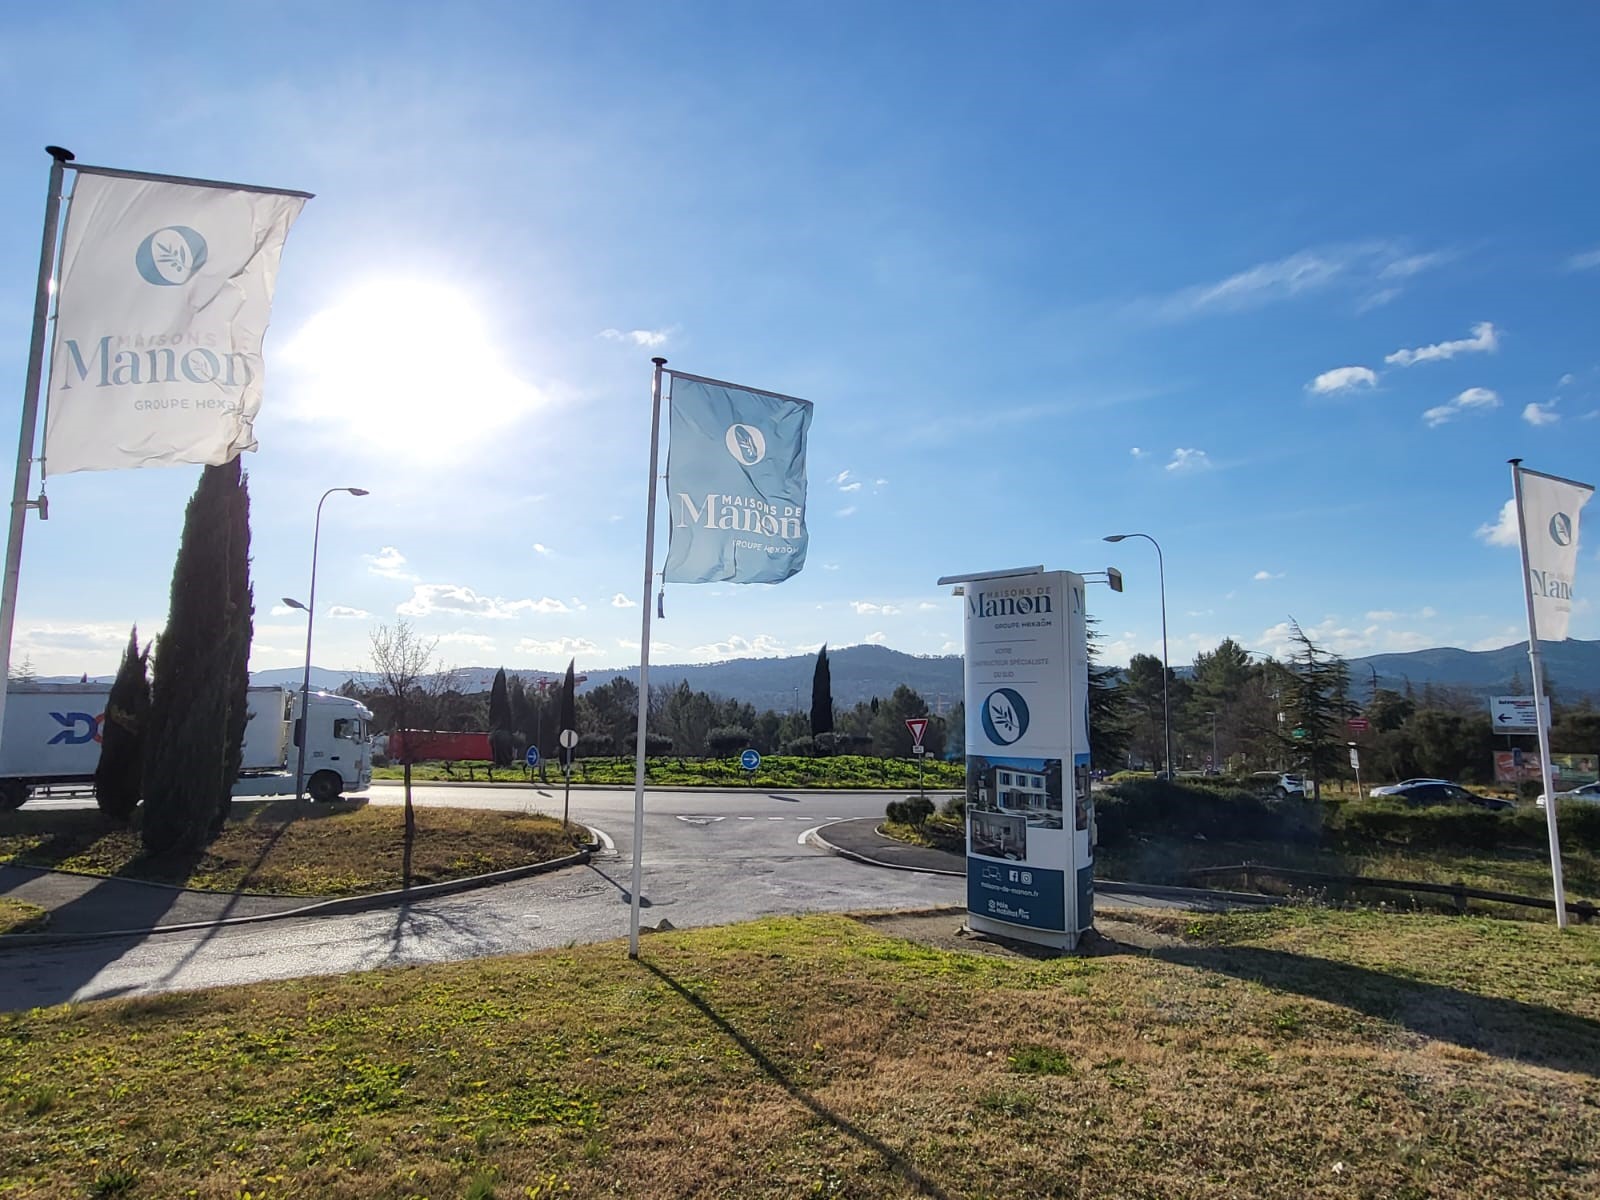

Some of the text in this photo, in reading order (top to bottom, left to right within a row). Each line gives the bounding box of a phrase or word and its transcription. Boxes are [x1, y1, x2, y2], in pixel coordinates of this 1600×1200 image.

[116, 332, 217, 348] MAISONS
[60, 335, 253, 390] Manon
[134, 398, 190, 411] GROUPE
[676, 492, 803, 540] Manon
[721, 494, 802, 517] MAISONS DE
[986, 586, 1051, 598] MAISONS DE
[967, 592, 1053, 620] Manon
